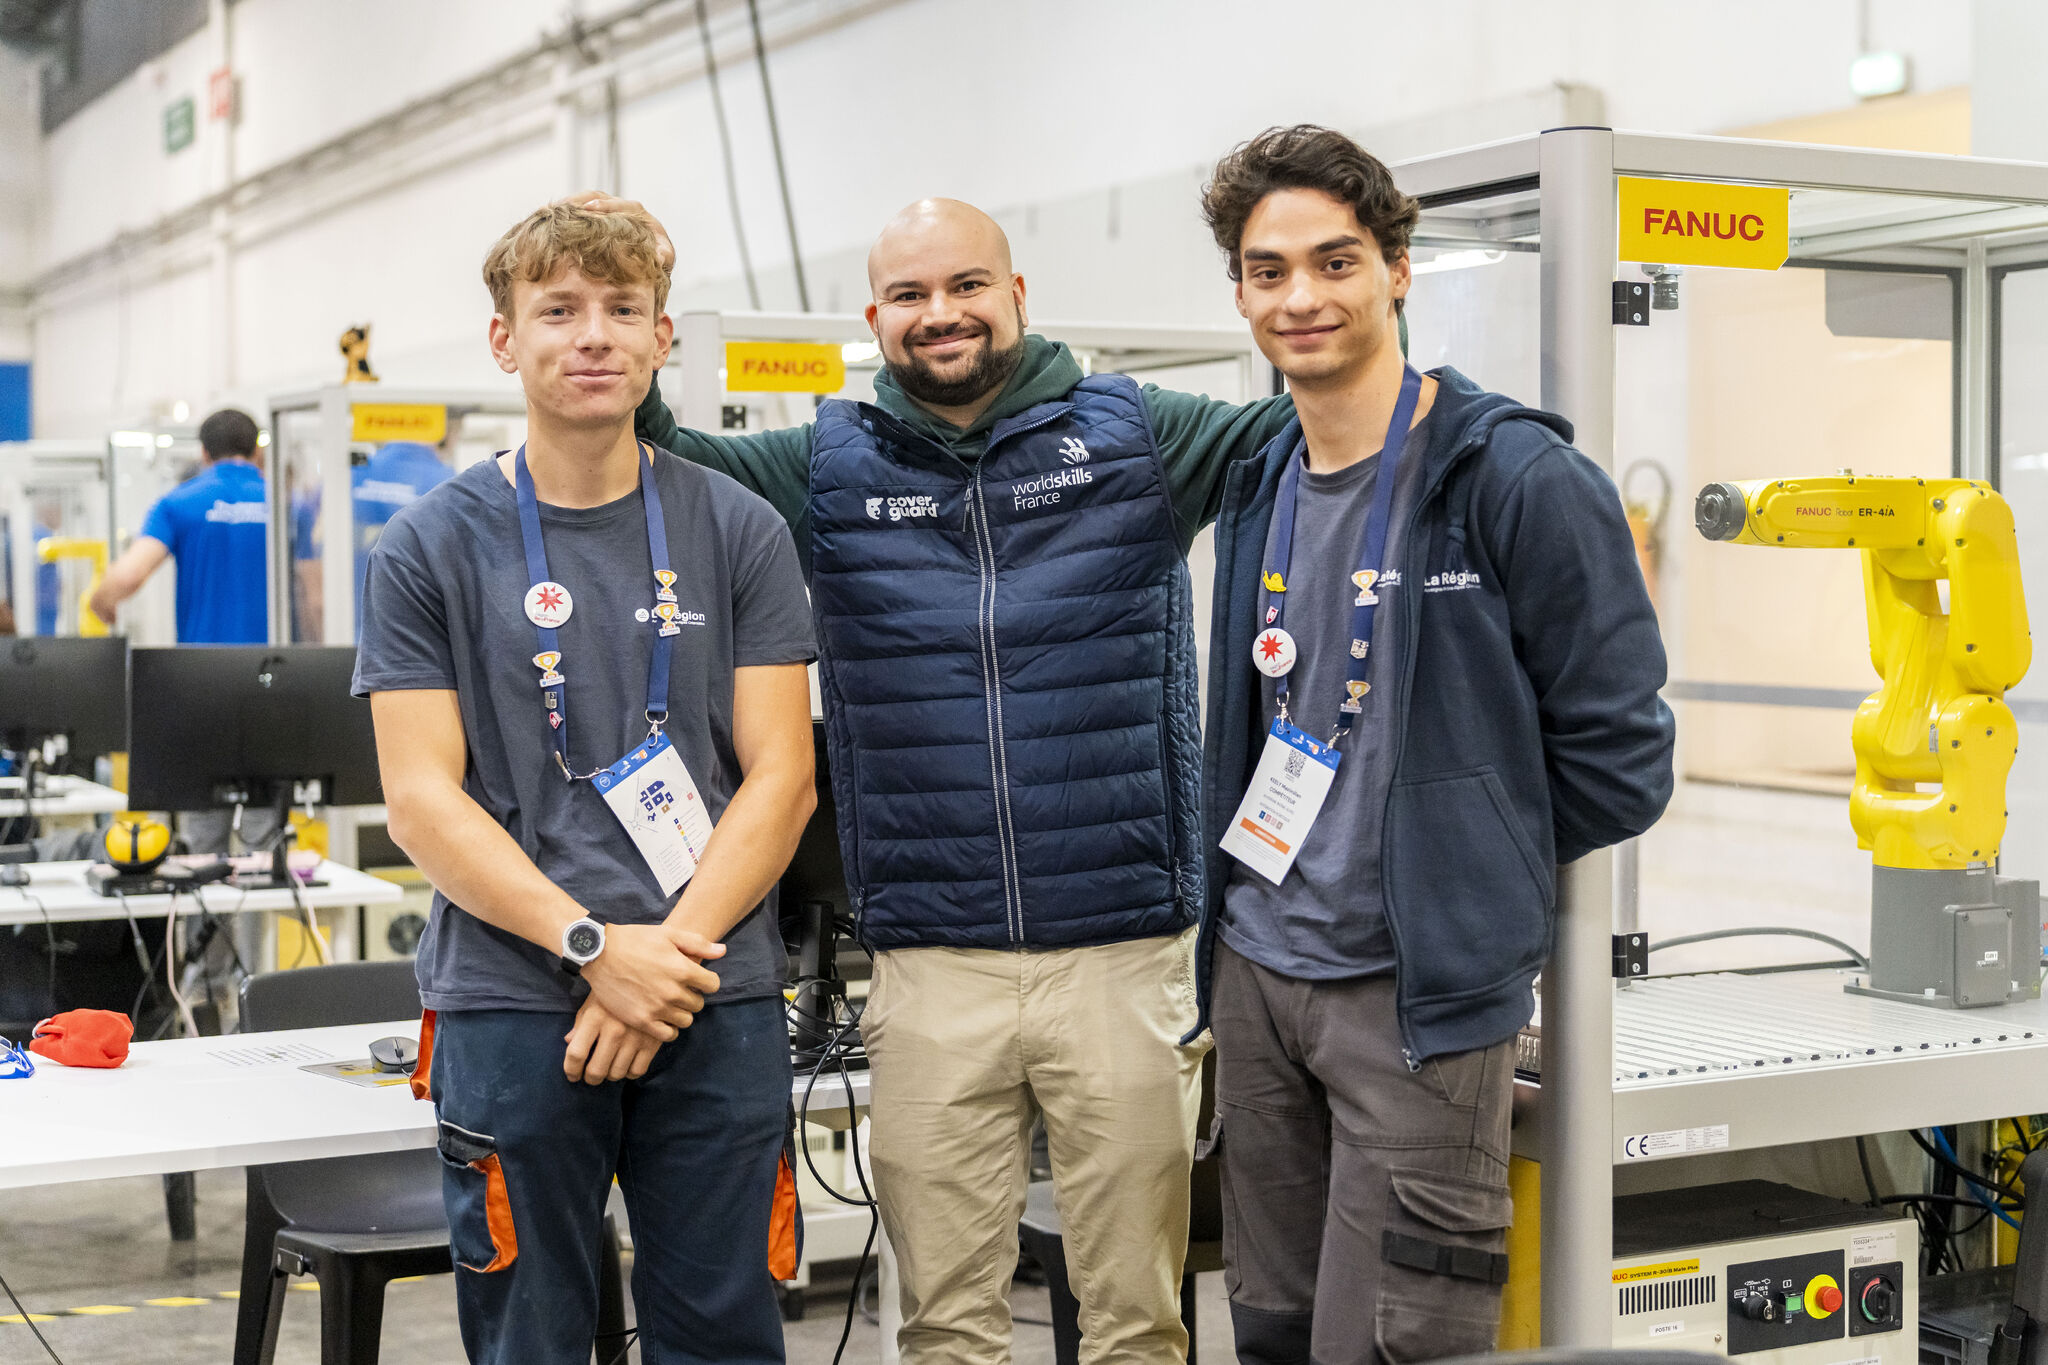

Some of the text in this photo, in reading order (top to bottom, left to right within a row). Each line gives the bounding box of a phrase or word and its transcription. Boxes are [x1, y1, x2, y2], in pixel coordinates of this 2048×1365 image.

[1644, 207, 1764, 241] FANUC
[742, 359, 828, 378] FANUC
[1011, 467, 1093, 495] worldskills
[886, 495, 933, 507] cover
[1014, 492, 1061, 511] France
[888, 502, 938, 521] guard
[1796, 507, 1832, 516] FANUC
[1835, 507, 1854, 516] Robot
[1424, 574, 1440, 586] La
[673, 609, 706, 622] égion
[1612, 1272, 1628, 1281] NUC
[1630, 1271, 1652, 1279] SYSTEM
